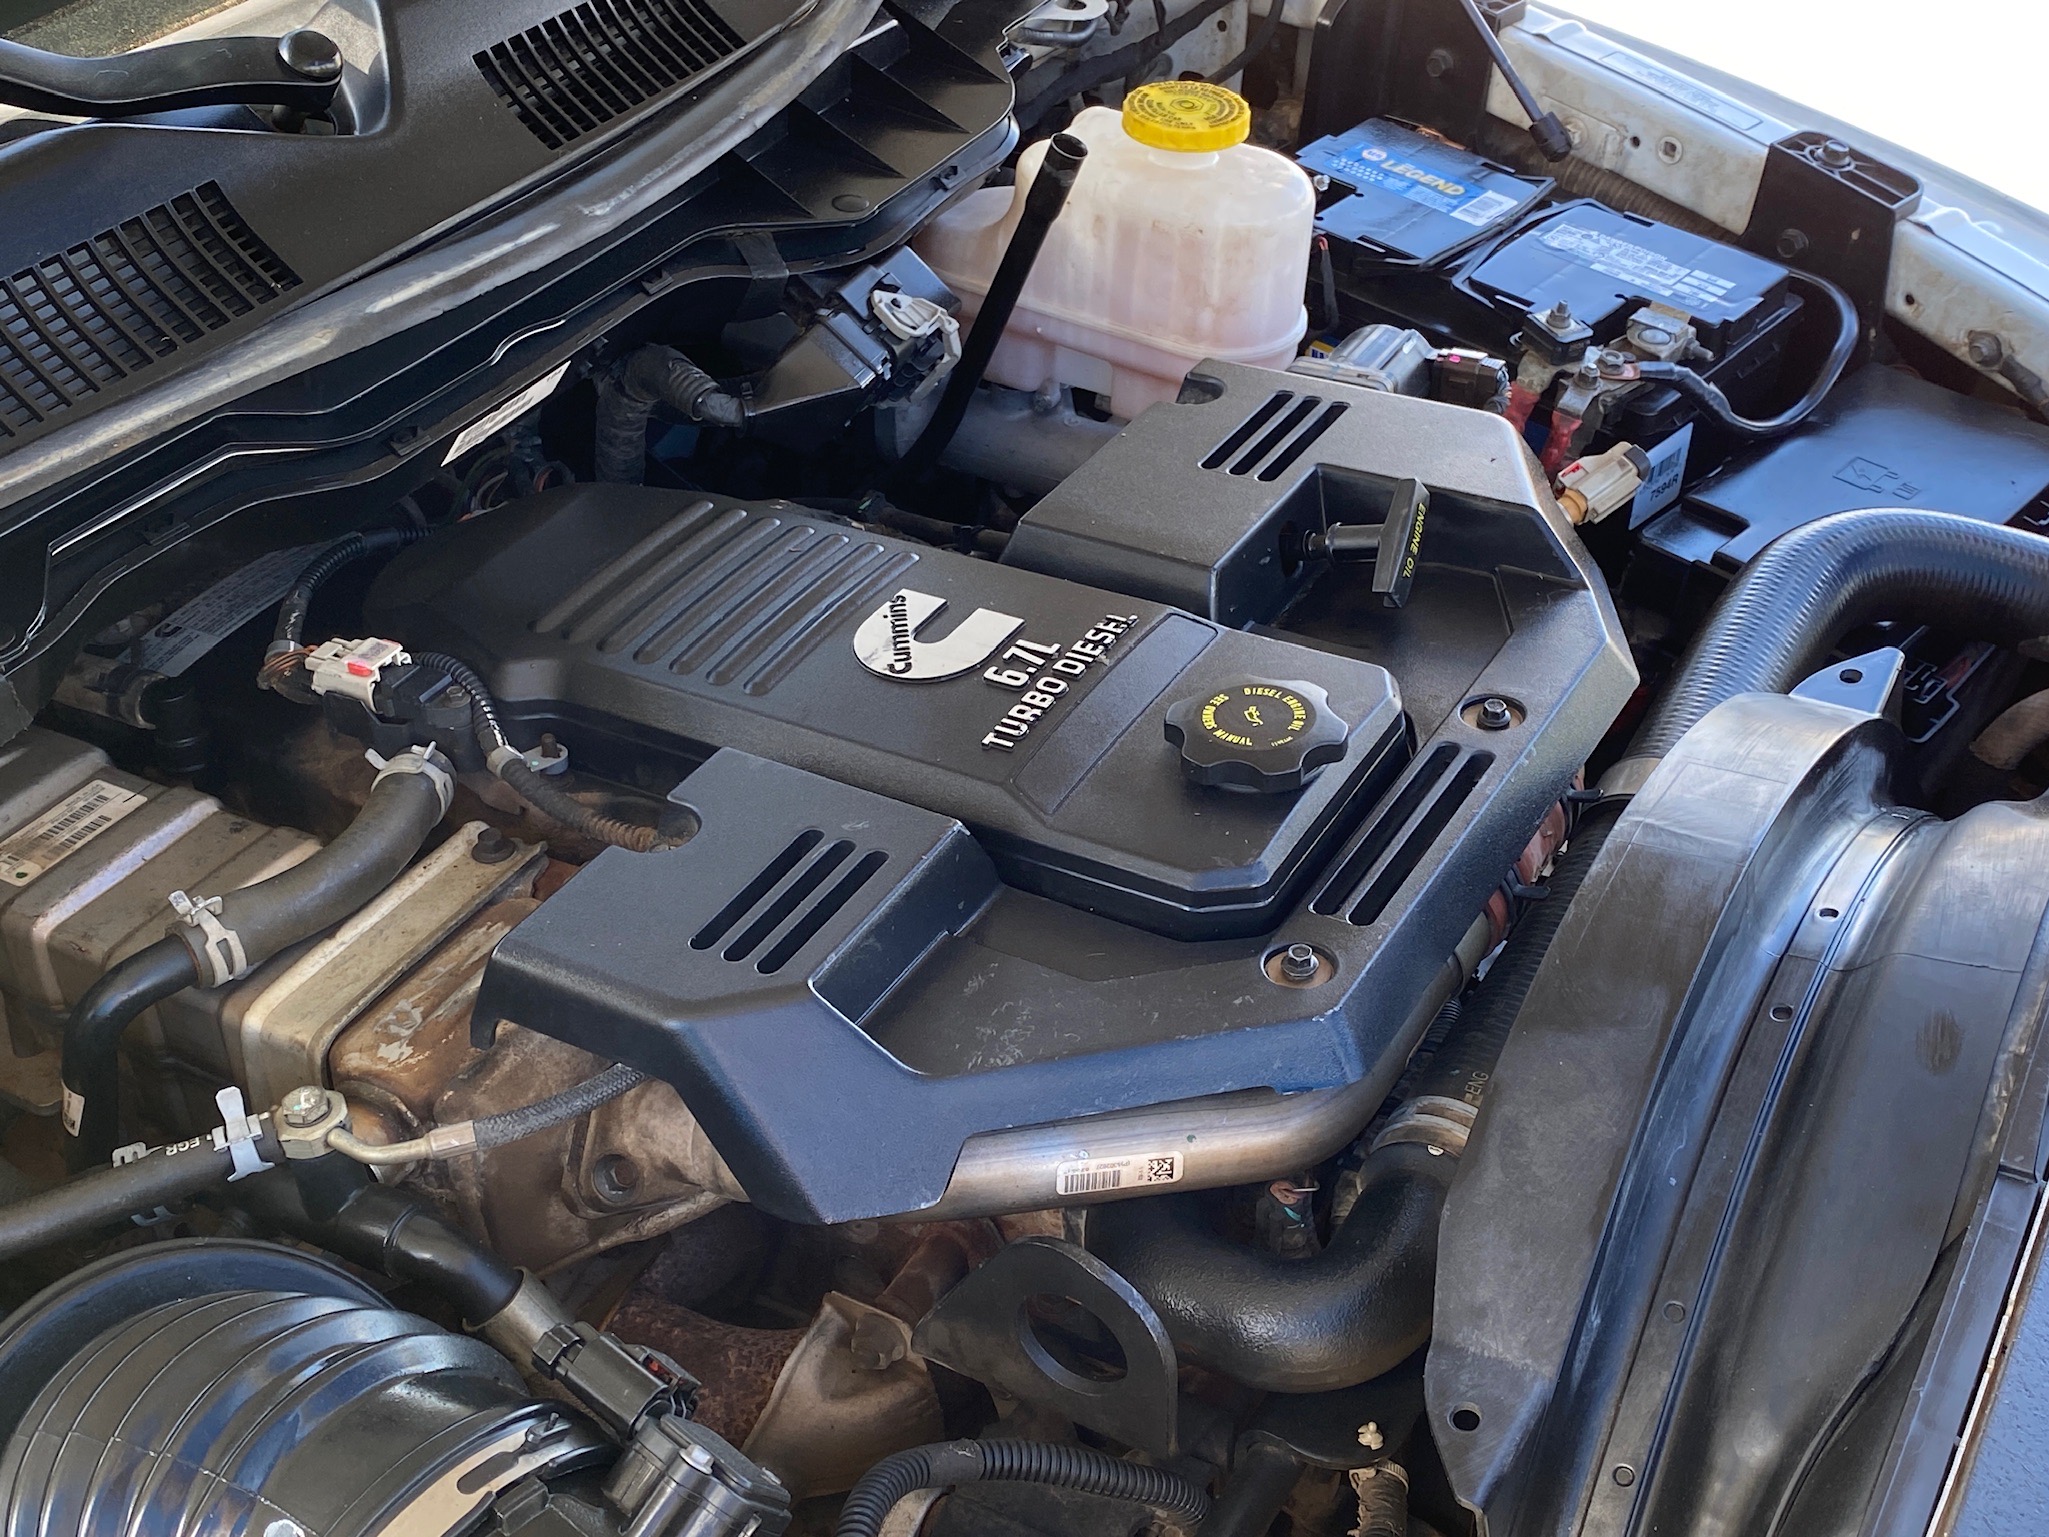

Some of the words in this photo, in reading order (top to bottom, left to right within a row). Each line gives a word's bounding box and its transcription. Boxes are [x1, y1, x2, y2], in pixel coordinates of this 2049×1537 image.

[1382, 160, 1465, 195] LEGEND
[1649, 472, 1679, 502] 7594R
[1410, 502, 1426, 555] ENGINE
[1402, 557, 1415, 579] OIL
[983, 637, 1062, 691] 6.7L
[981, 675, 1070, 754] TURBO
[1051, 613, 1140, 680] DIESEL
[1243, 688, 1282, 699] DIESEL
[1209, 693, 1230, 706] SEE
[1282, 695, 1306, 720] ENGINE
[1212, 728, 1253, 746] MANUAL
[1287, 720, 1306, 732] OIL
[1464, 1070, 1489, 1095] ENG
[165, 1136, 201, 1157] EGR
